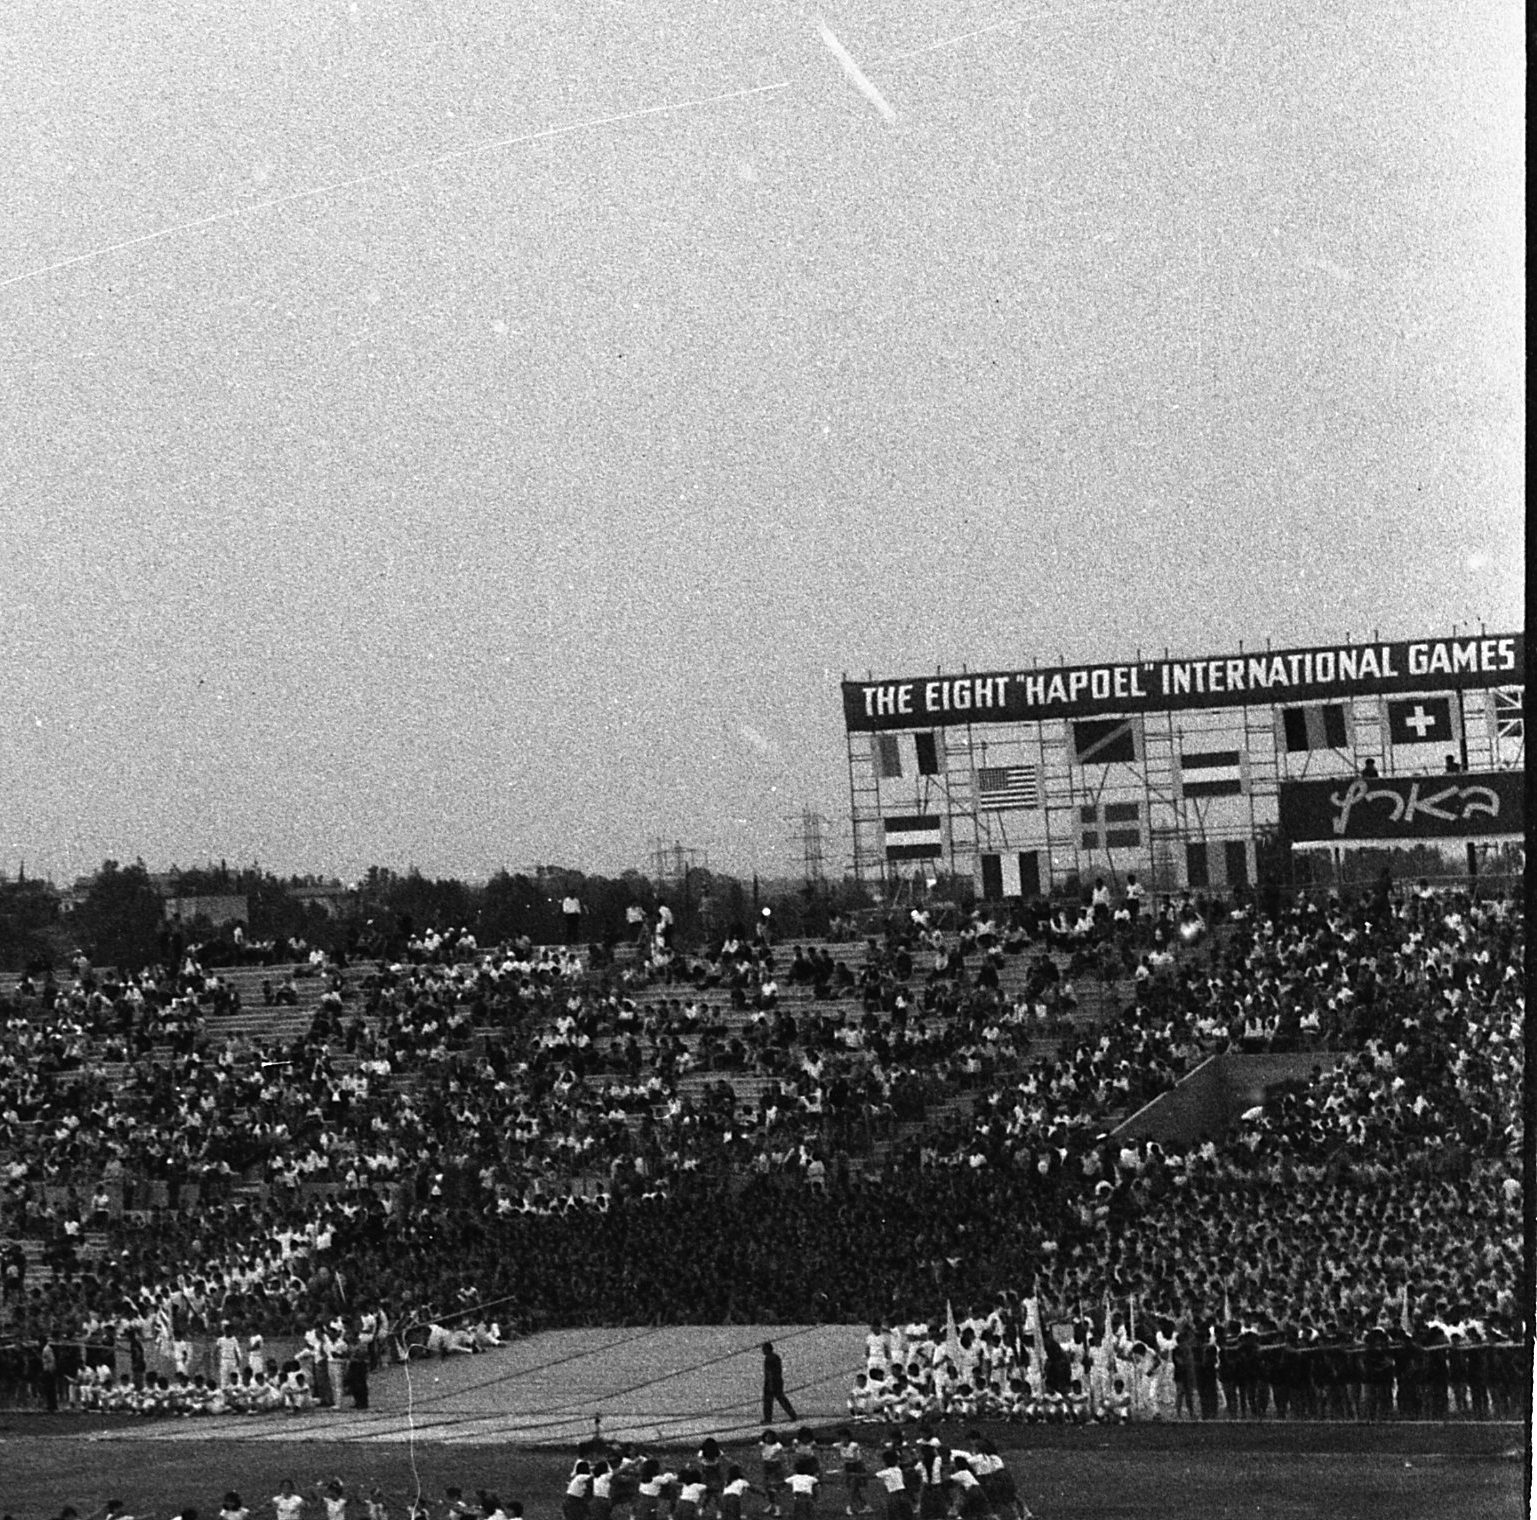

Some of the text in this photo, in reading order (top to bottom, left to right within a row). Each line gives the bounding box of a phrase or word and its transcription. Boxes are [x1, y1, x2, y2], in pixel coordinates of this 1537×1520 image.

[862, 638, 1516, 716] THE EIGHT "HAPOEL" INTERNATIONAL GAMES
[1329, 780, 1500, 835] בארץ
